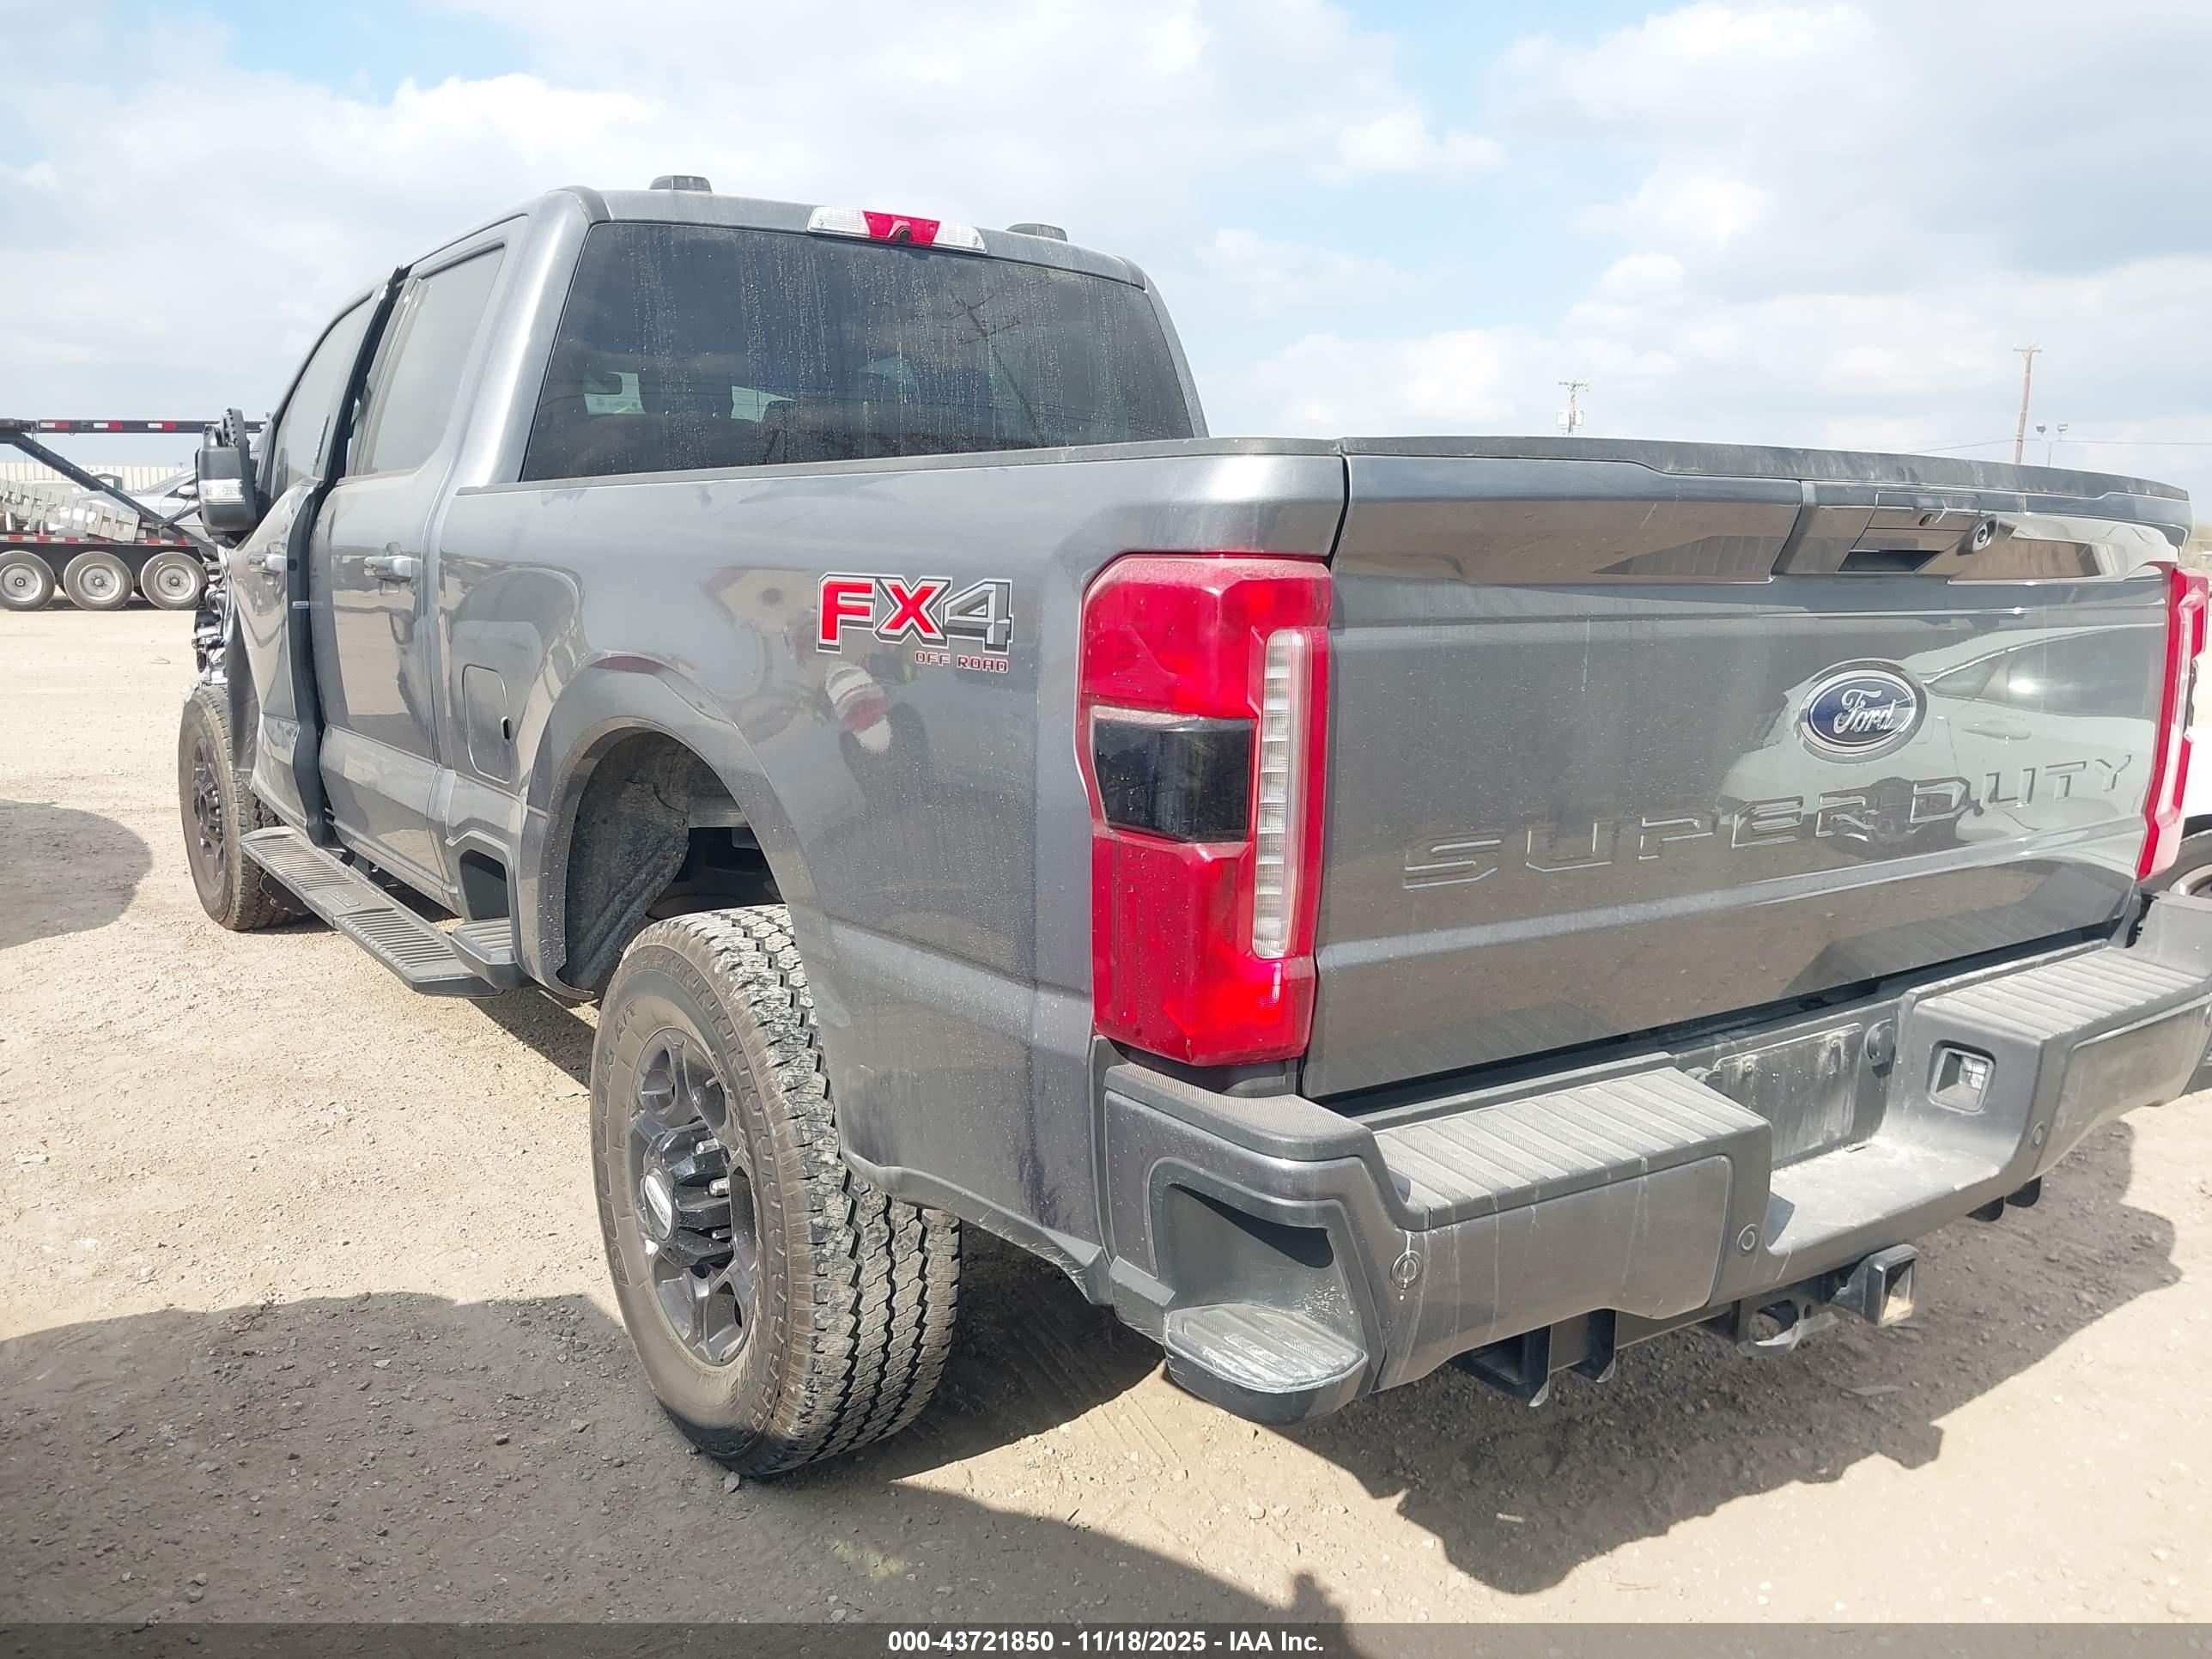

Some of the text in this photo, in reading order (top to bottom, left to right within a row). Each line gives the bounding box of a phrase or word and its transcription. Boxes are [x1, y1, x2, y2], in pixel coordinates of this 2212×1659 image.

[817, 572, 1014, 654] FX4
[915, 651, 1009, 673] OFF ROAD
[1832, 690, 1897, 733] Ford
[1403, 753, 2132, 890] SUPER DUTY
